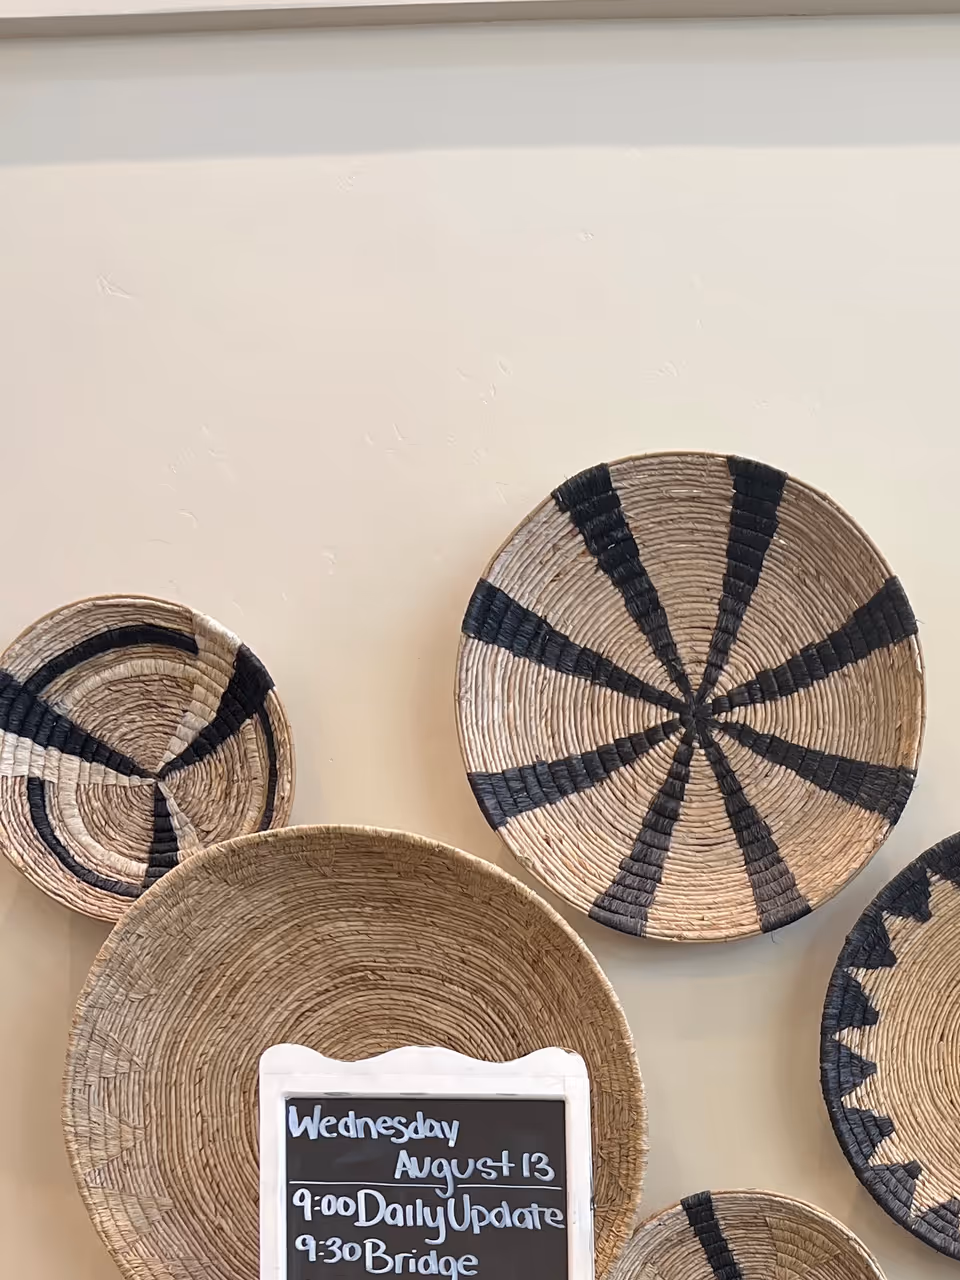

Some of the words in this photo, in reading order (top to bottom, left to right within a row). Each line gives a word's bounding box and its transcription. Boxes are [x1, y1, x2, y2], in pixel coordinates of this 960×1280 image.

[288, 1104, 460, 1148] Wednesday
[394, 1149, 516, 1199] August
[522, 1152, 555, 1182] 13
[292, 1188, 356, 1221] 9:00
[354, 1189, 446, 1245] Daily
[447, 1194, 566, 1235] Update
[295, 1234, 361, 1264] 9:30
